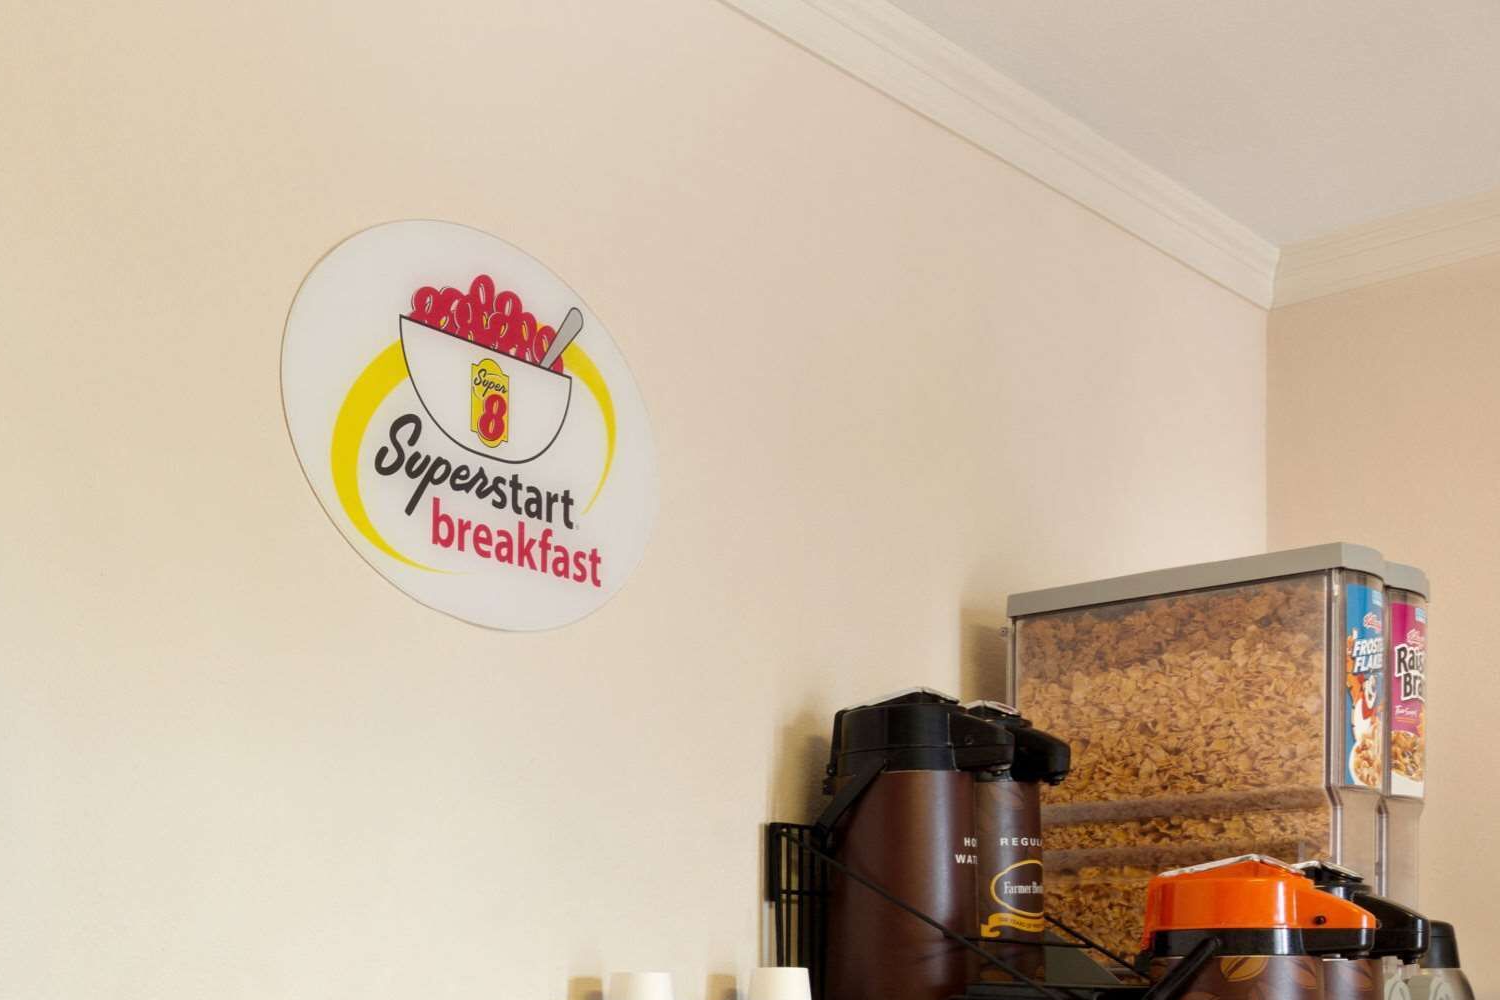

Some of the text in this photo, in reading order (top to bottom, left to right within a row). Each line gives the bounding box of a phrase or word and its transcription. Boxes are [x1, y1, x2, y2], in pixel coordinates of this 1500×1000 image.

[473, 368, 507, 397] Super
[479, 393, 507, 442] 8
[373, 412, 576, 530] Superstart
[431, 496, 603, 588] breakfast
[1396, 645, 1425, 674] Rais
[1402, 672, 1425, 698] Bra
[963, 837, 978, 848] HO
